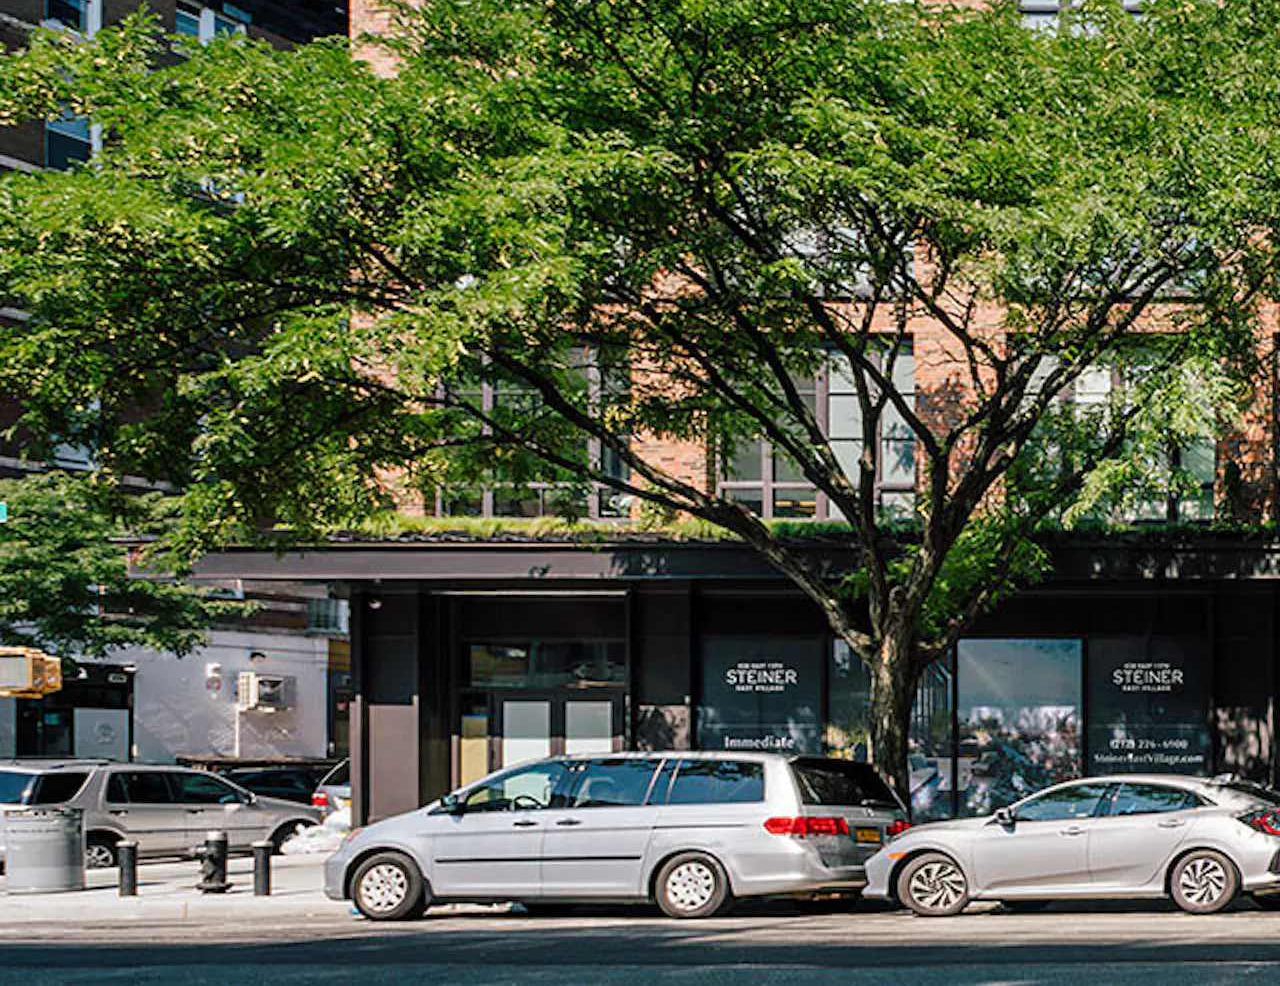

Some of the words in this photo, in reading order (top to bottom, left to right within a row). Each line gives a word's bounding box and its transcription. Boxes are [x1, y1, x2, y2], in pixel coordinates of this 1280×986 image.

[726, 668, 798, 685] STEINER
[1112, 668, 1184, 685] STEINER
[724, 735, 795, 749] Immediate
